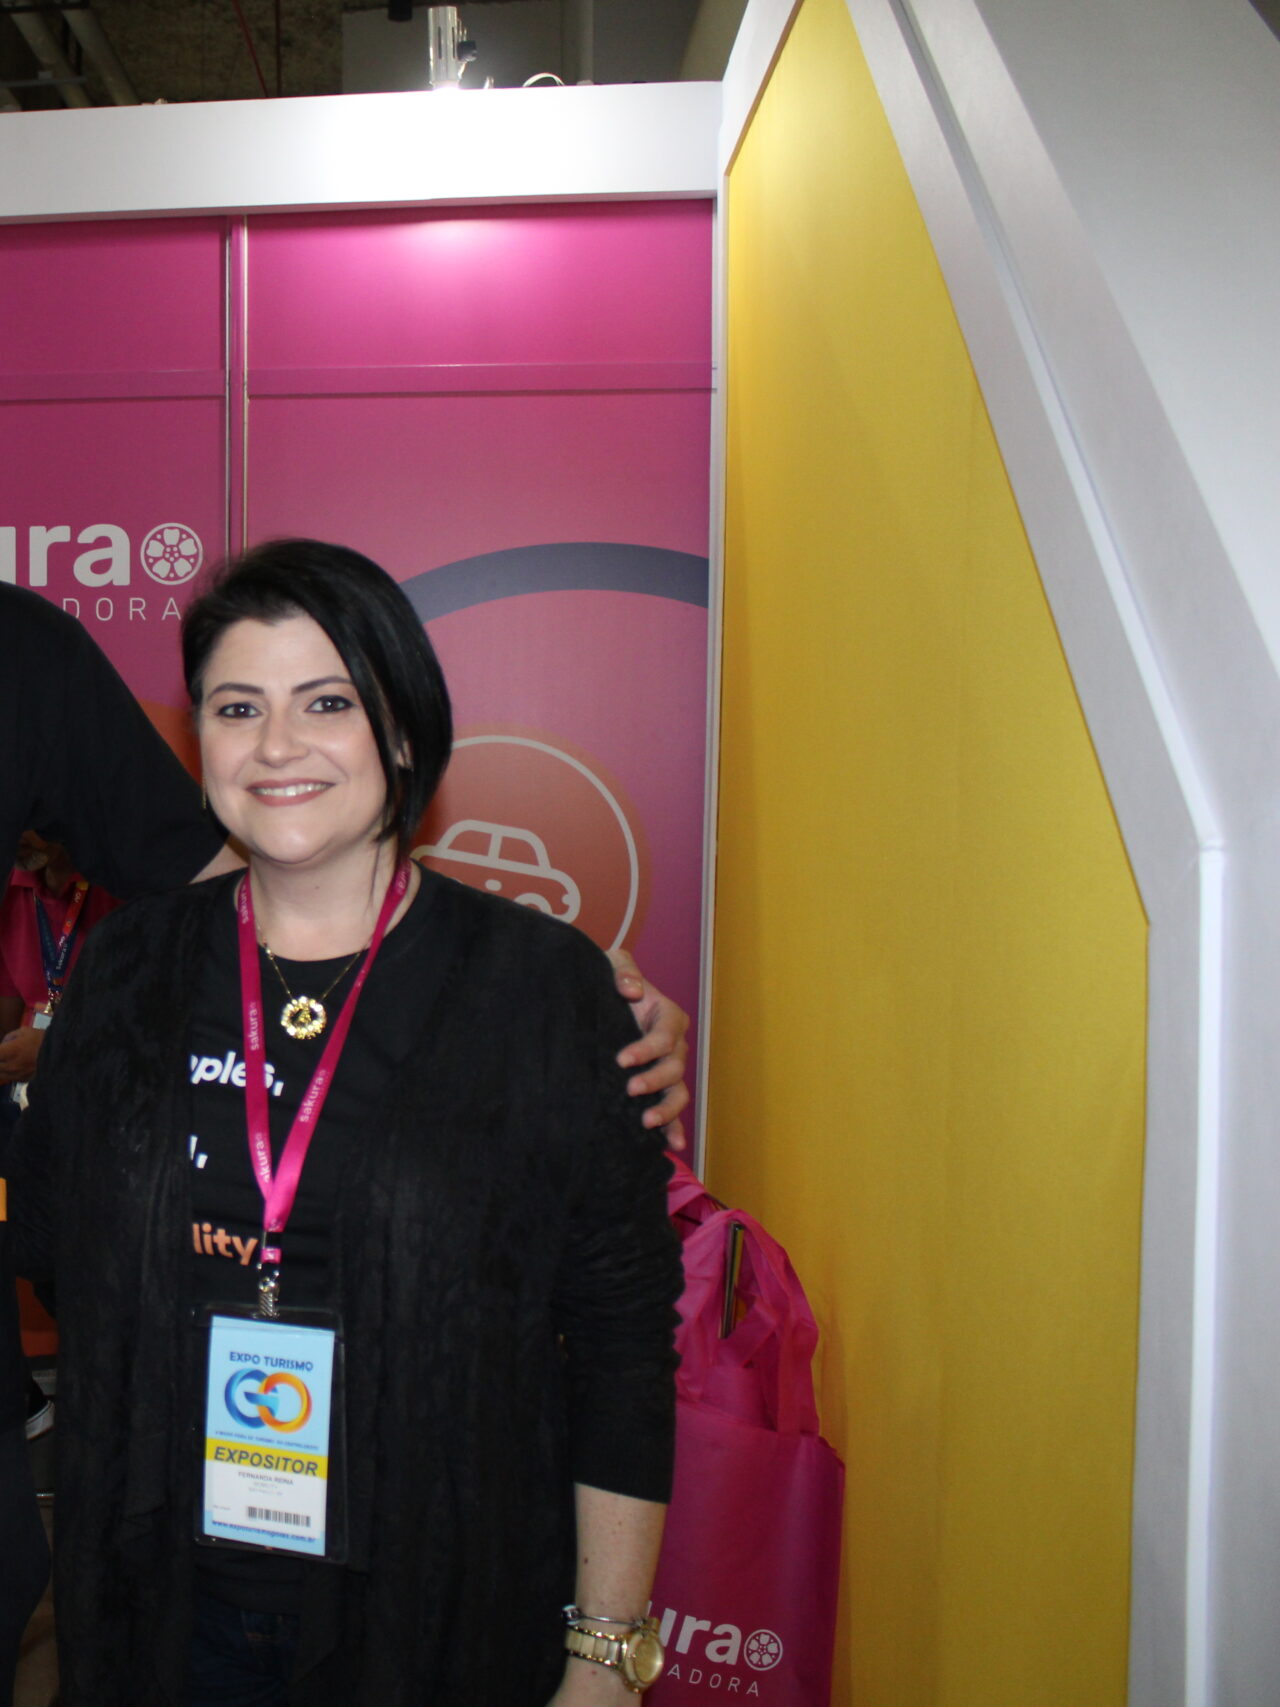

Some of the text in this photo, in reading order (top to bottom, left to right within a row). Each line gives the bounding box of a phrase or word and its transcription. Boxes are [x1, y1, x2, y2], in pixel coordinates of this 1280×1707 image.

[249, 1009, 260, 1051] sakura
[191, 1050, 284, 1096] ples,
[300, 1077, 324, 1122] sakura
[229, 1351, 313, 1372] EXPO TURISMO
[214, 1446, 318, 1476] EXPOSITOR
[667, 1663, 759, 1697] ADORA
